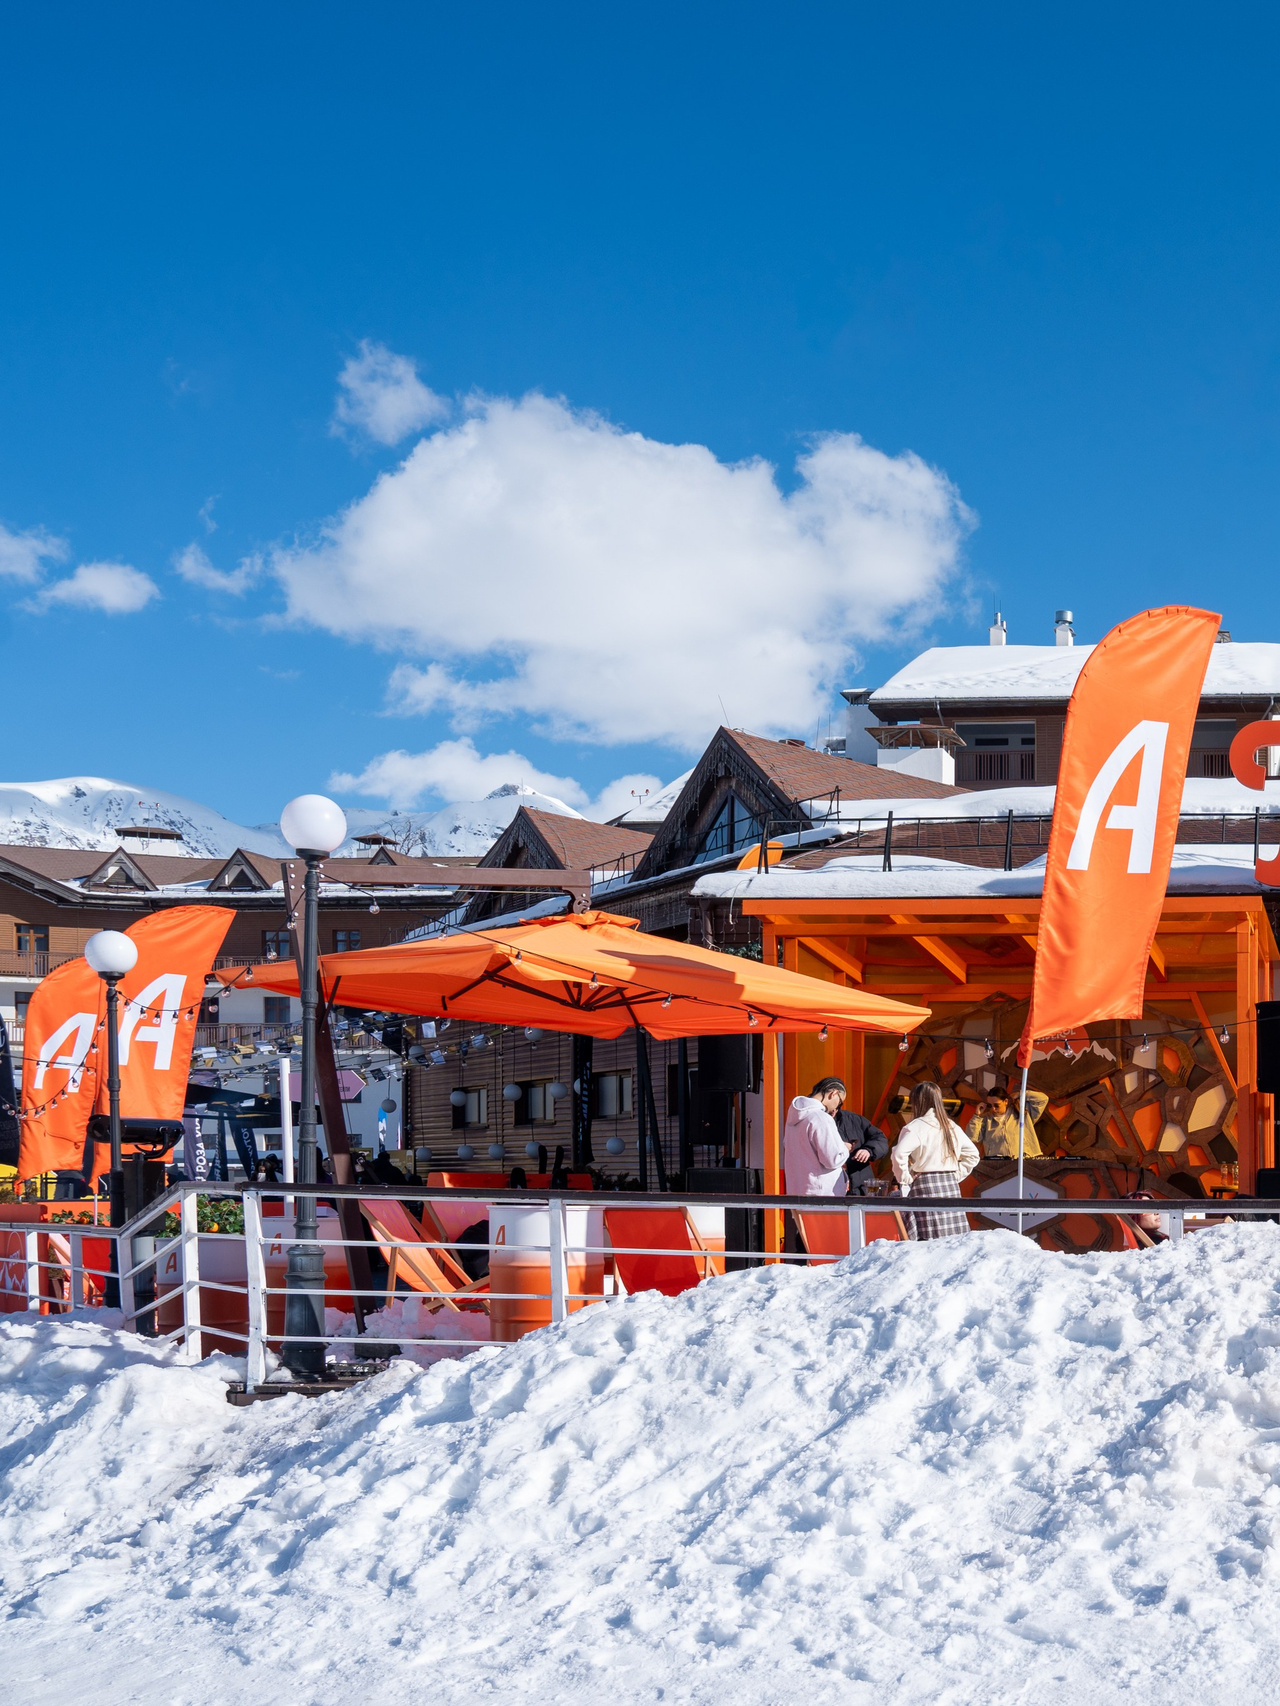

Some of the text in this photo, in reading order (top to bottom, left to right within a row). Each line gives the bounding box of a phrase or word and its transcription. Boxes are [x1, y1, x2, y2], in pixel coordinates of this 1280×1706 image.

[1067, 719, 1170, 874] A
[117, 973, 188, 1070] A
[33, 1012, 98, 1093] A
[195, 1142, 206, 1173] РОЗА
[269, 1232, 282, 1257] A
[495, 1224, 506, 1254] A
[165, 1251, 177, 1275] A
